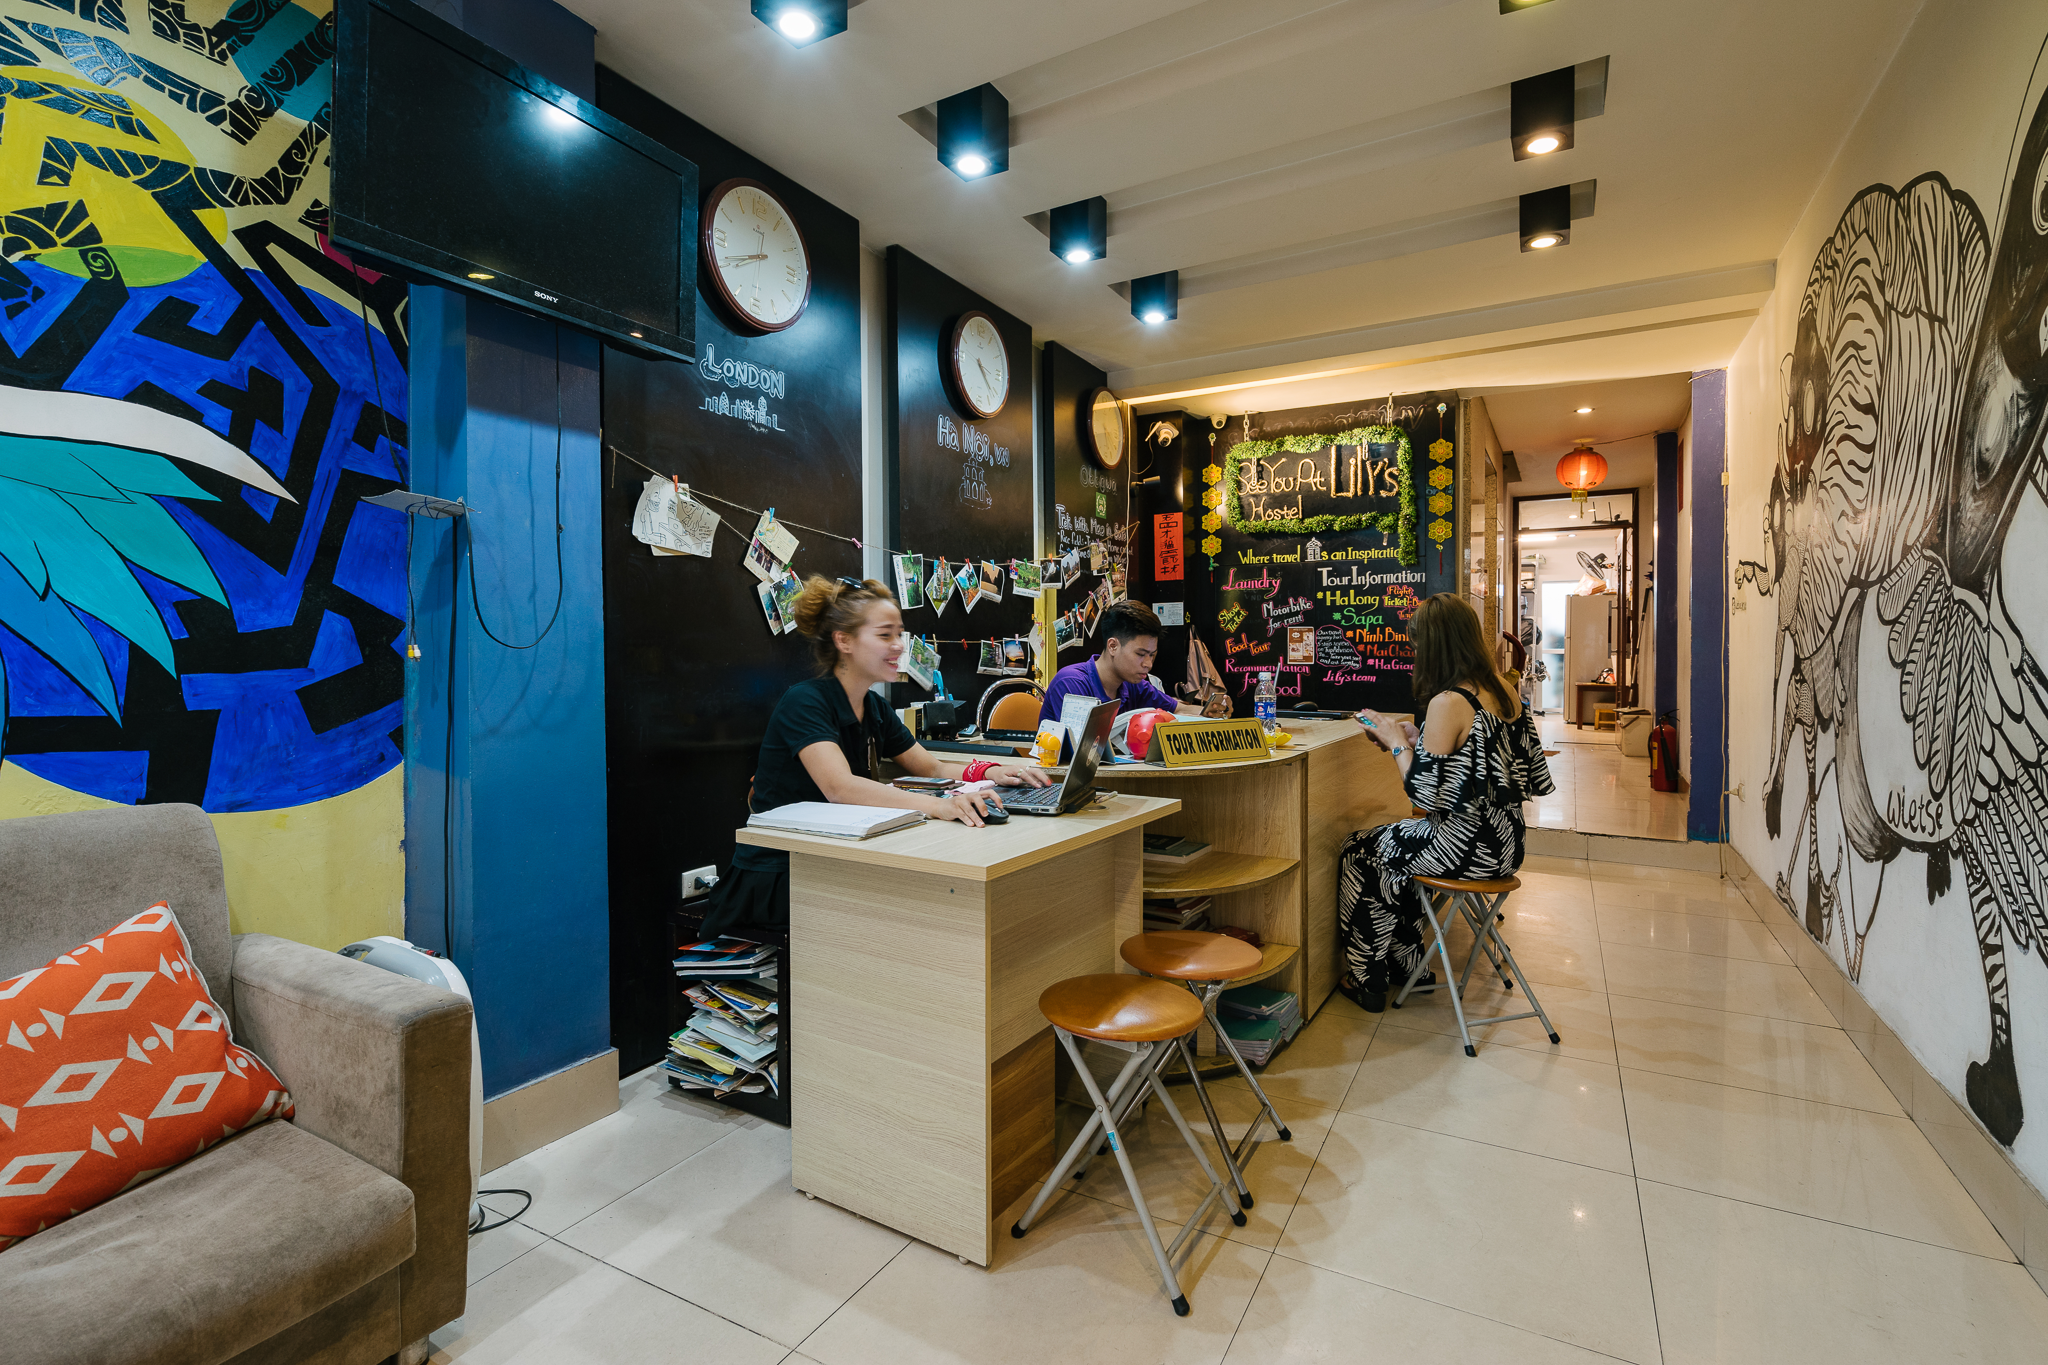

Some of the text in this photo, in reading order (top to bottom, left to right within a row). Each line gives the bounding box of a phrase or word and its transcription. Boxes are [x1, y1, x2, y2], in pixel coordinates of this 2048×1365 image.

[534, 290, 559, 304] SONY
[700, 344, 784, 399] LONDON
[1236, 444, 1400, 499] See You At Lily's
[1249, 495, 1303, 522] Hostel
[1238, 548, 1270, 565] Where
[1273, 544, 1301, 563] travel
[1330, 550, 1347, 560] an
[1347, 546, 1401, 564] Inspiratio
[1221, 566, 1281, 600] Laundry
[1317, 565, 1426, 590] Tour Information
[1325, 590, 1349, 606] Ha
[1349, 589, 1380, 615] Long
[1388, 585, 1412, 598] Flight
[1218, 602, 1241, 626] Show
[1267, 613, 1304, 637] for rent
[1340, 606, 1385, 632] Sapa
[1225, 632, 1271, 656] Food Tour
[1356, 627, 1383, 643] Ninh
[1367, 644, 1388, 657] Mai
[1322, 669, 1377, 686] Lily's team
[1374, 658, 1416, 676] Ha Gian
[1238, 672, 1259, 697] for
[1166, 728, 1263, 756] TOUR INFORMATION
[1886, 784, 1944, 838] Wietse
